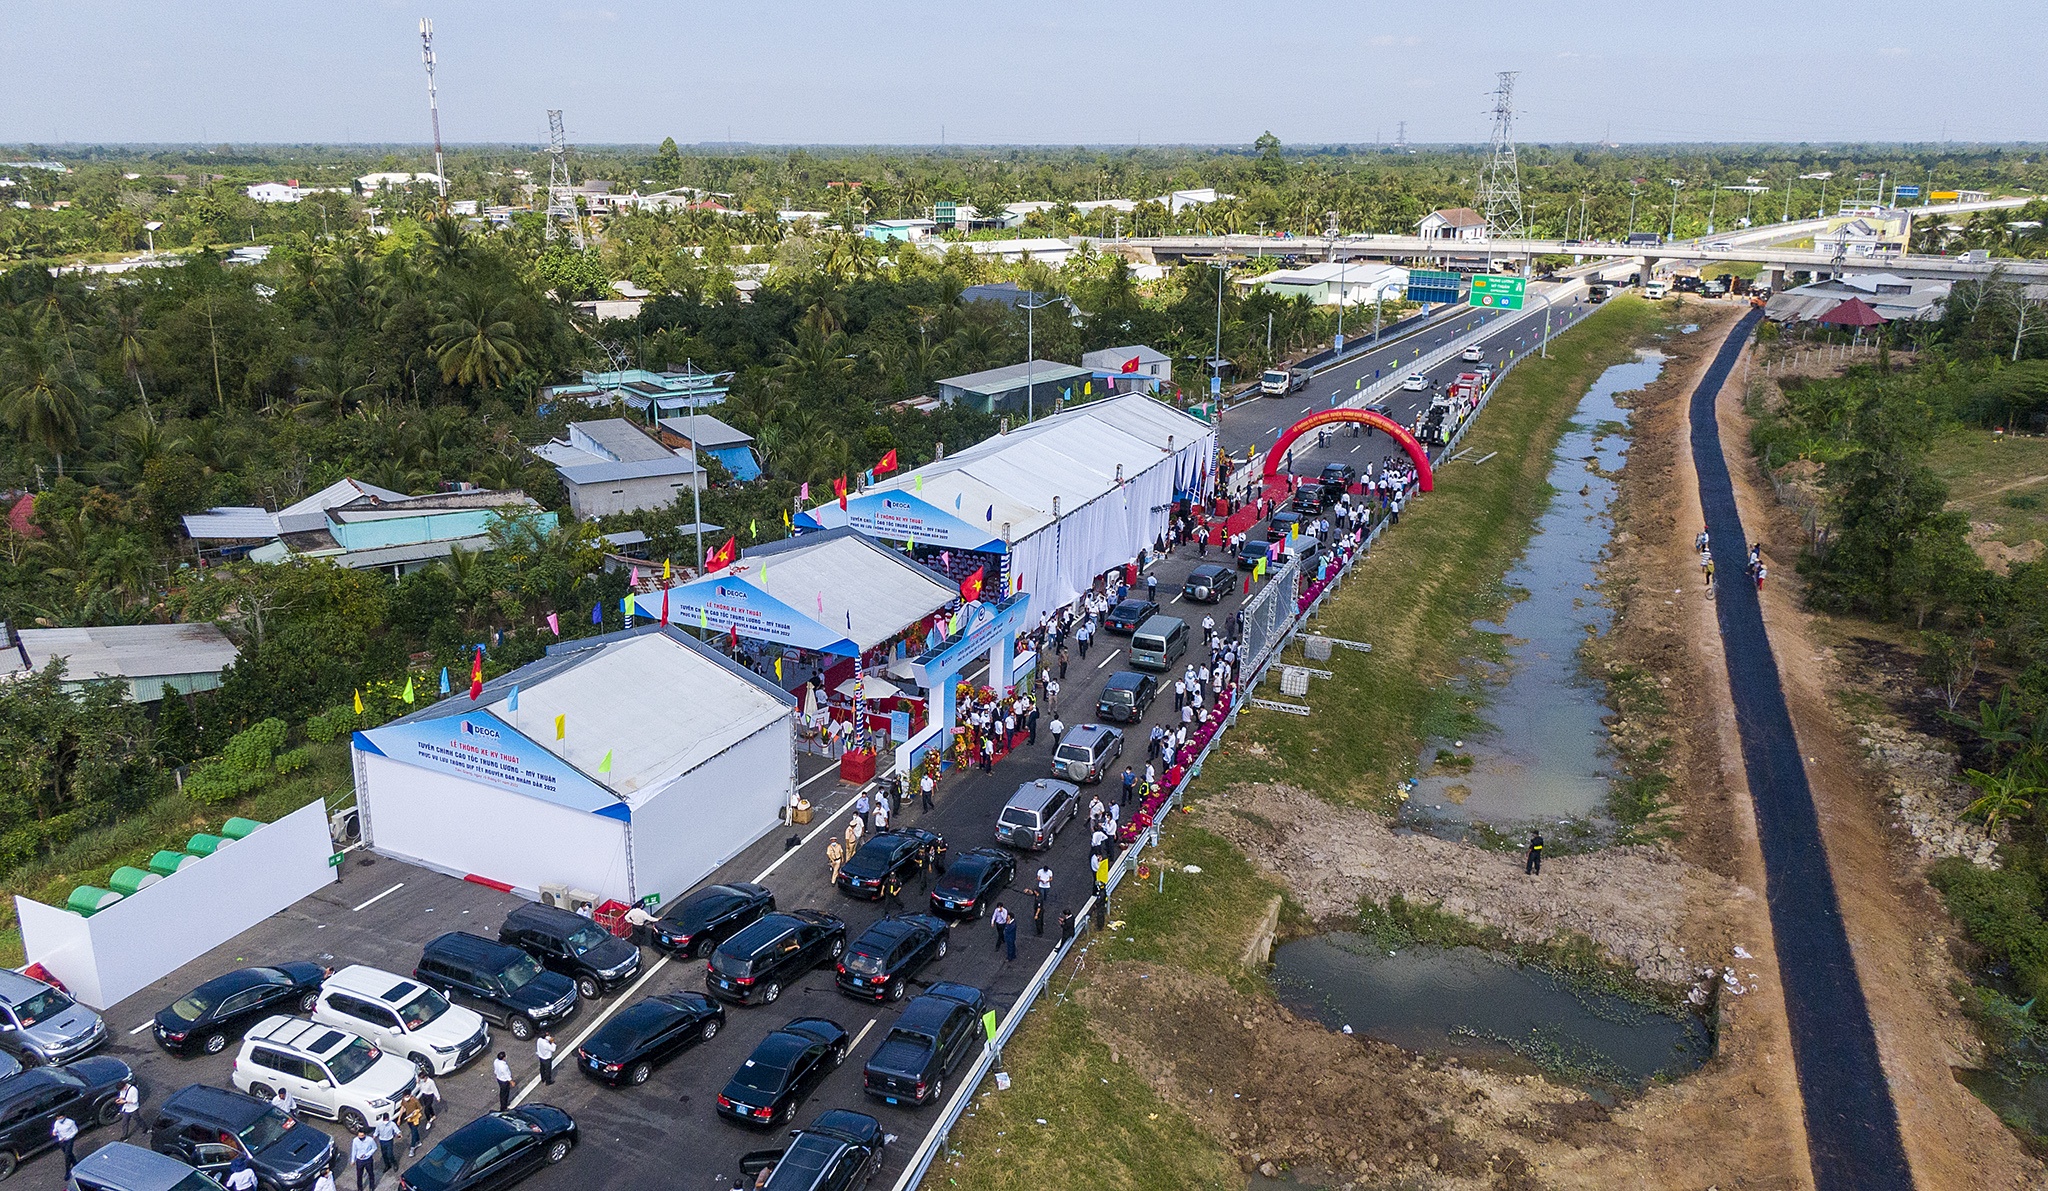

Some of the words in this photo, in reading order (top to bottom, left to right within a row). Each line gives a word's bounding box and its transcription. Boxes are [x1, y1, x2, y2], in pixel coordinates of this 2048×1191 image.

[726, 589, 748, 599] DEOCA
[474, 726, 501, 739] DEOCA
[459, 742, 480, 754] THÔNG
[454, 751, 467, 760] CAO
[479, 758, 499, 769] TRUNG
[543, 783, 557, 793] 2022
